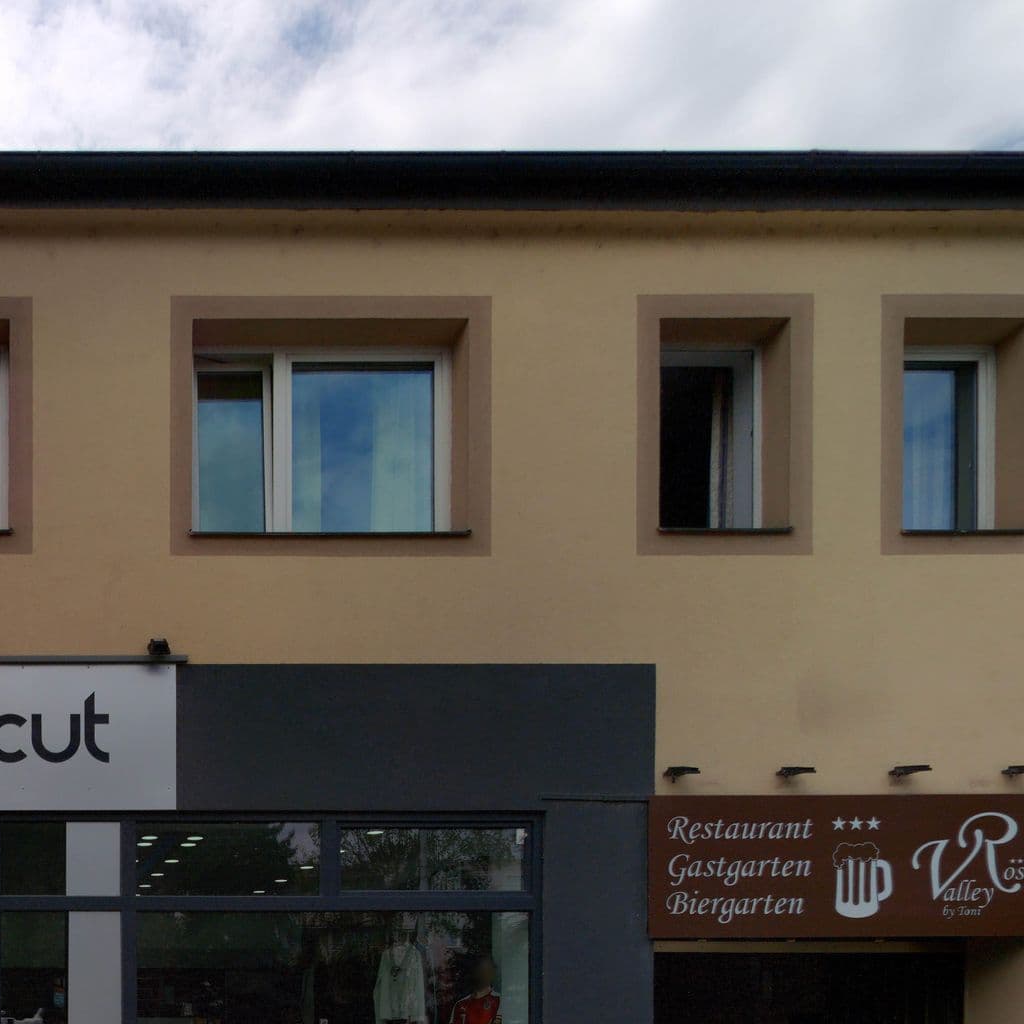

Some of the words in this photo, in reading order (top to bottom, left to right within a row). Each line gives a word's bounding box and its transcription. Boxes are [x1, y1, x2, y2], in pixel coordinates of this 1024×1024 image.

[667, 816, 814, 844] Restaurant
[668, 853, 812, 886] Gastgarten
[912, 828, 994, 909] Valley
[666, 890, 805, 923] Biergarten
